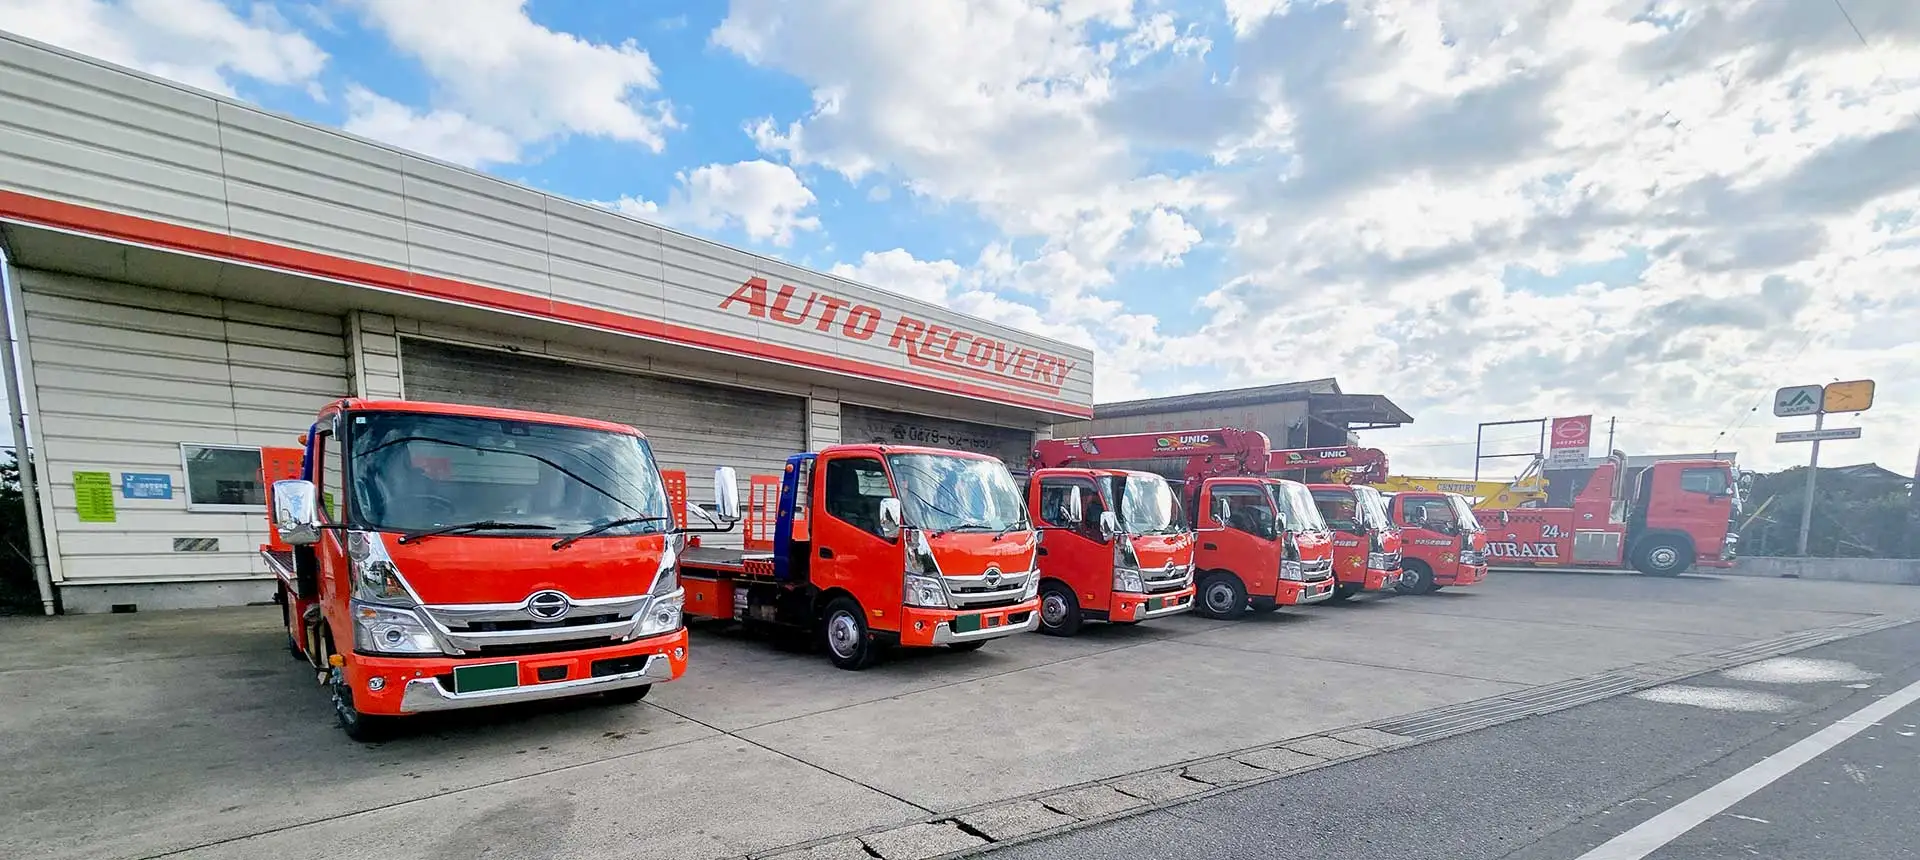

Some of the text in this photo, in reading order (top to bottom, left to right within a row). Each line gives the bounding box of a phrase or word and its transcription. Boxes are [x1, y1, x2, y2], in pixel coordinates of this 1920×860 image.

[718, 276, 1077, 391] AUTO RECOVERY
[1180, 435, 1209, 444] UNIC
[1320, 450, 1347, 458] UNIC
[1437, 483, 1477, 493] CENTURY
